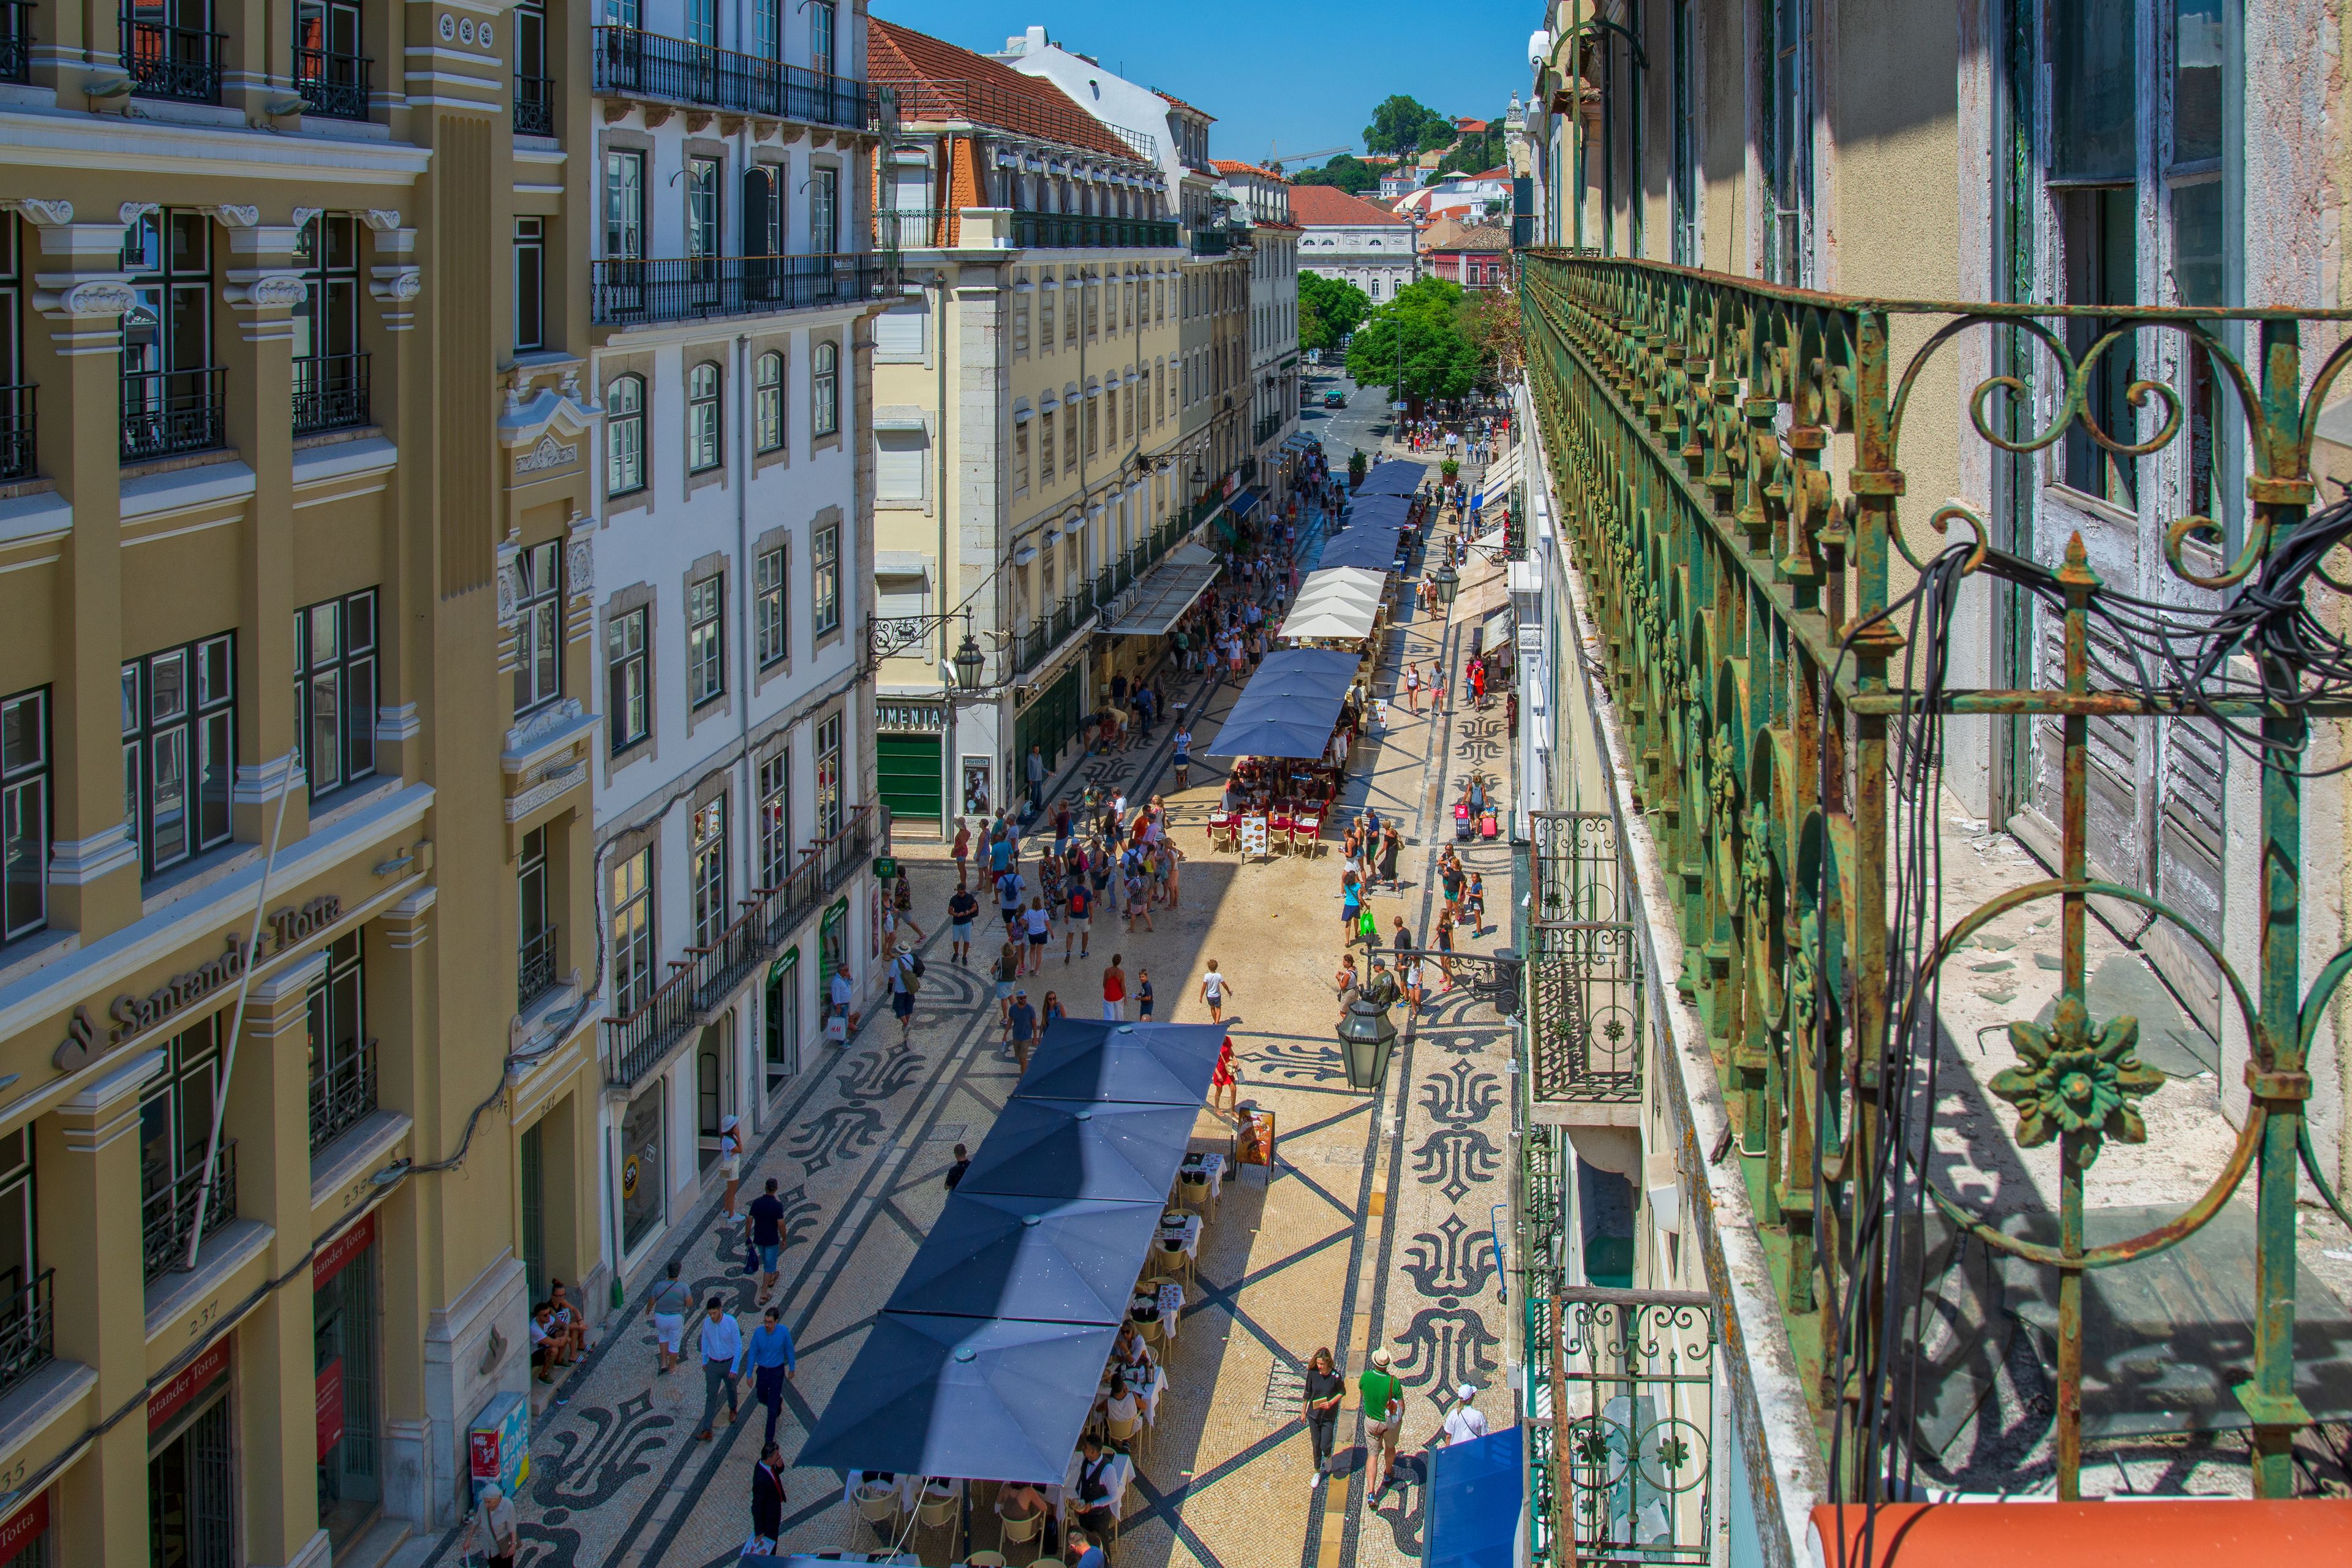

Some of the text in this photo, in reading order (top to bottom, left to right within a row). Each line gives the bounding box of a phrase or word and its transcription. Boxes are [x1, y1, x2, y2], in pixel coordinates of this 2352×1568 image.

[269, 895, 343, 949] Totta
[541, 1093, 556, 1115] 241
[344, 1178, 368, 1208] 239
[344, 1226, 367, 1250] Totta
[190, 1299, 218, 1336] 237
[191, 1353, 219, 1381] Totta
[0, 1512, 34, 1548] Totta
